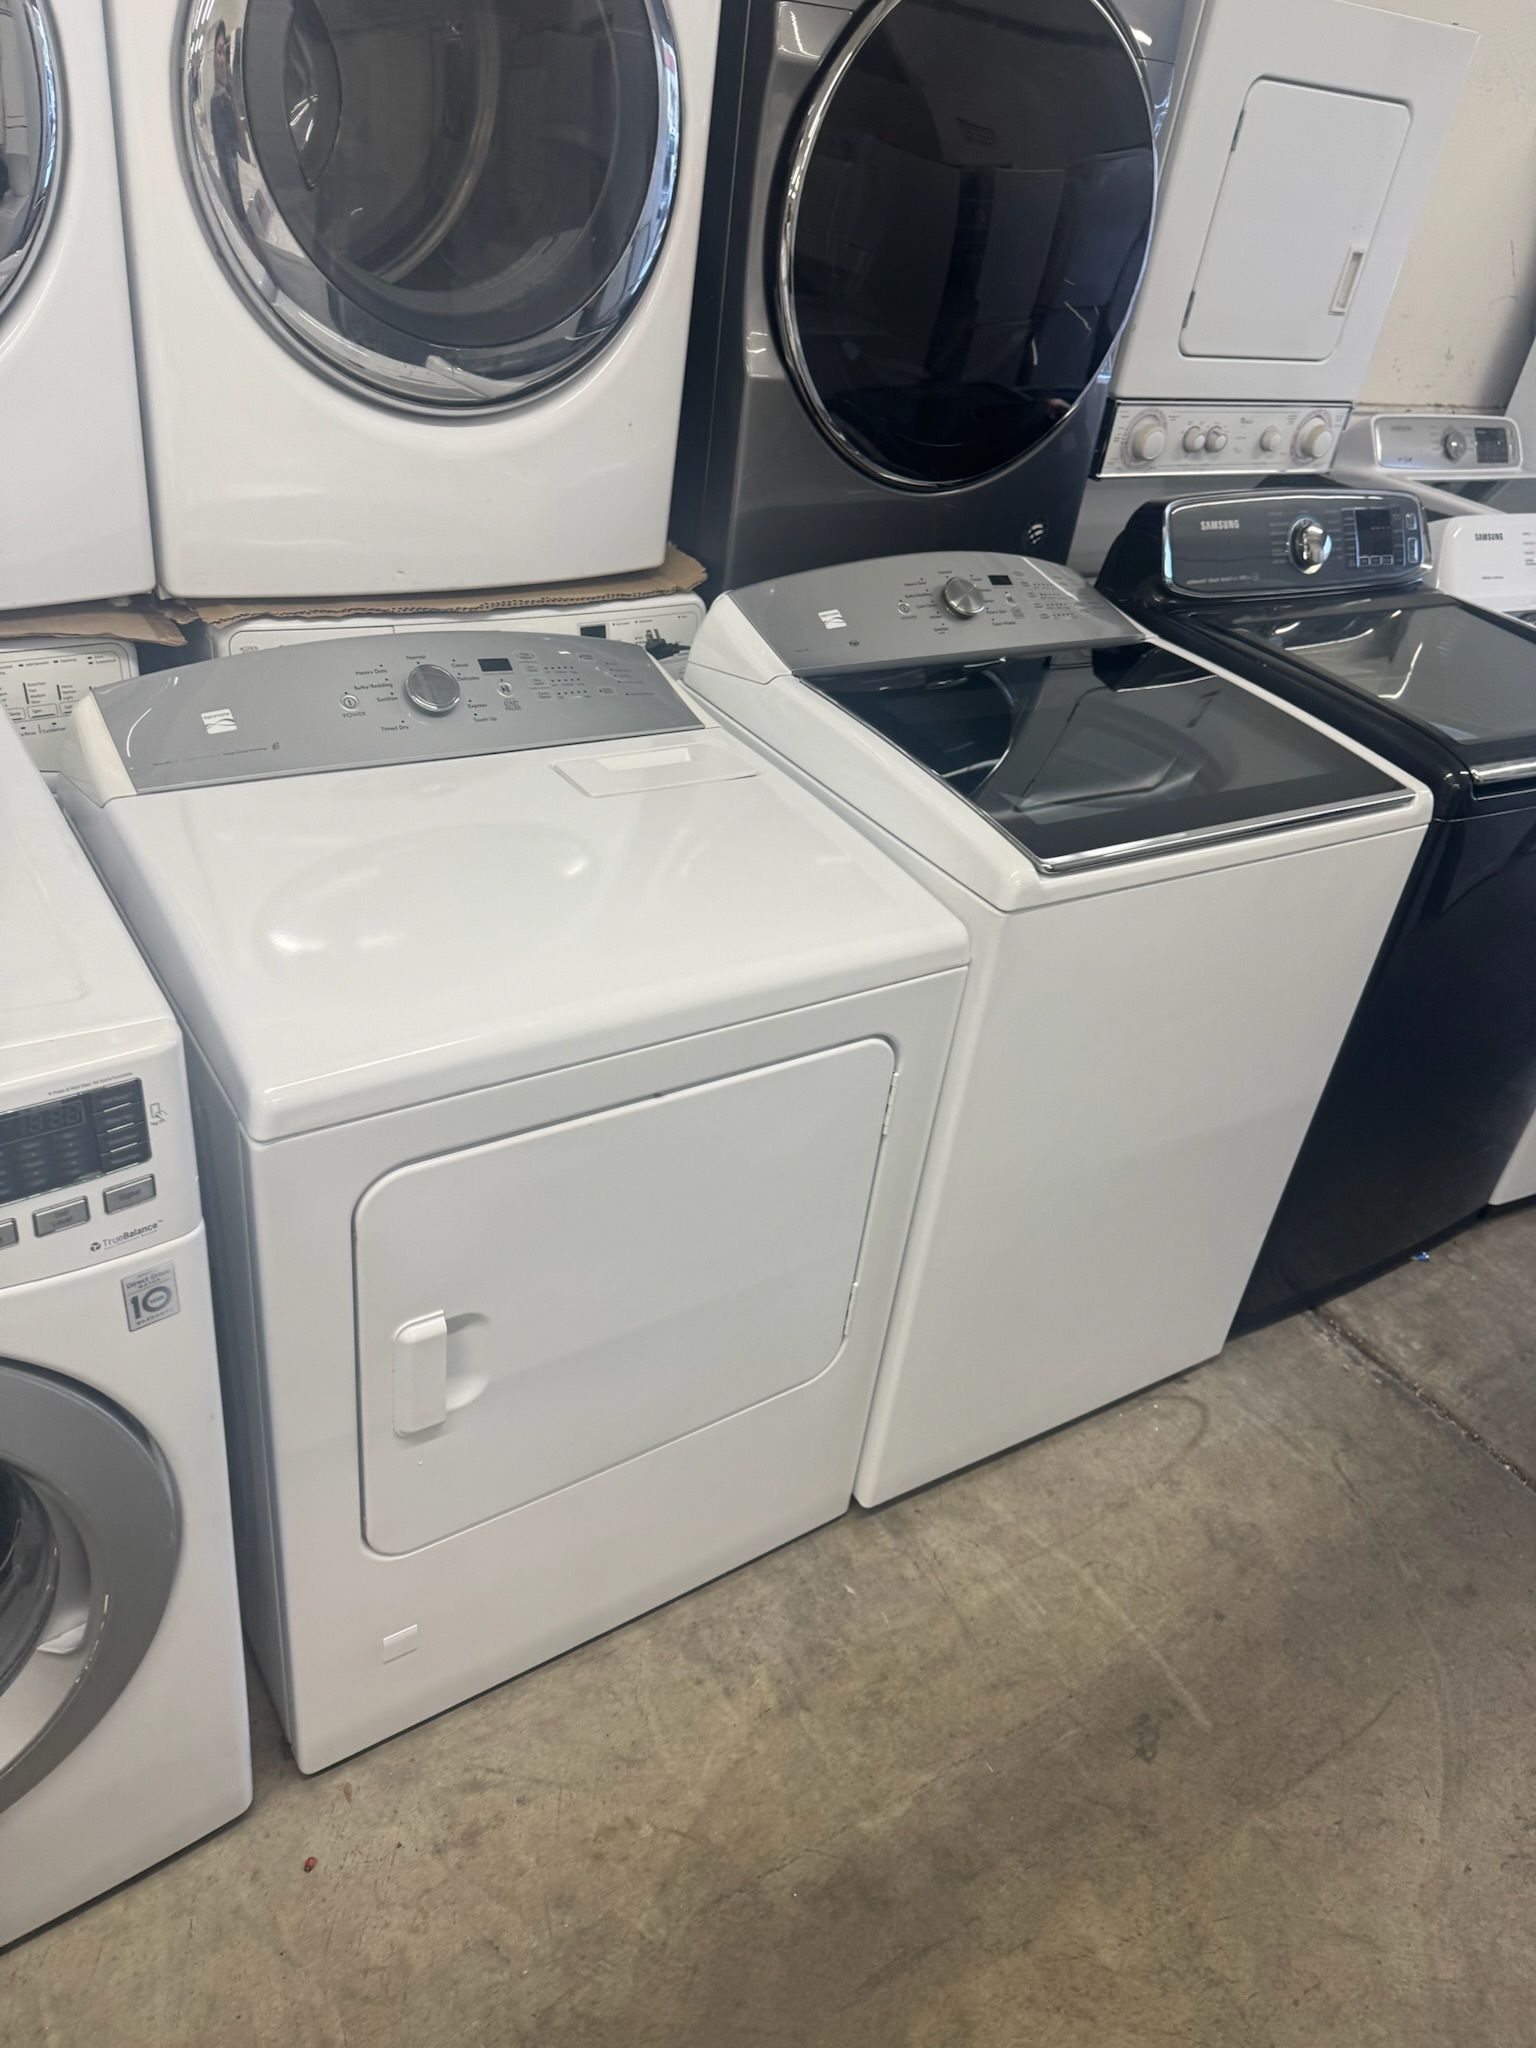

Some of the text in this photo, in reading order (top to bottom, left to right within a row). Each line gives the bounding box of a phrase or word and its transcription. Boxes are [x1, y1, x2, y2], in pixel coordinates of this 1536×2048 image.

[1200, 519, 1241, 531] SAMSUNG
[1474, 532, 1504, 541] SAMSUNG
[342, 711, 366, 719] POWER
[103, 1222, 158, 1247] TrueBalance
[131, 1286, 173, 1320] 10
